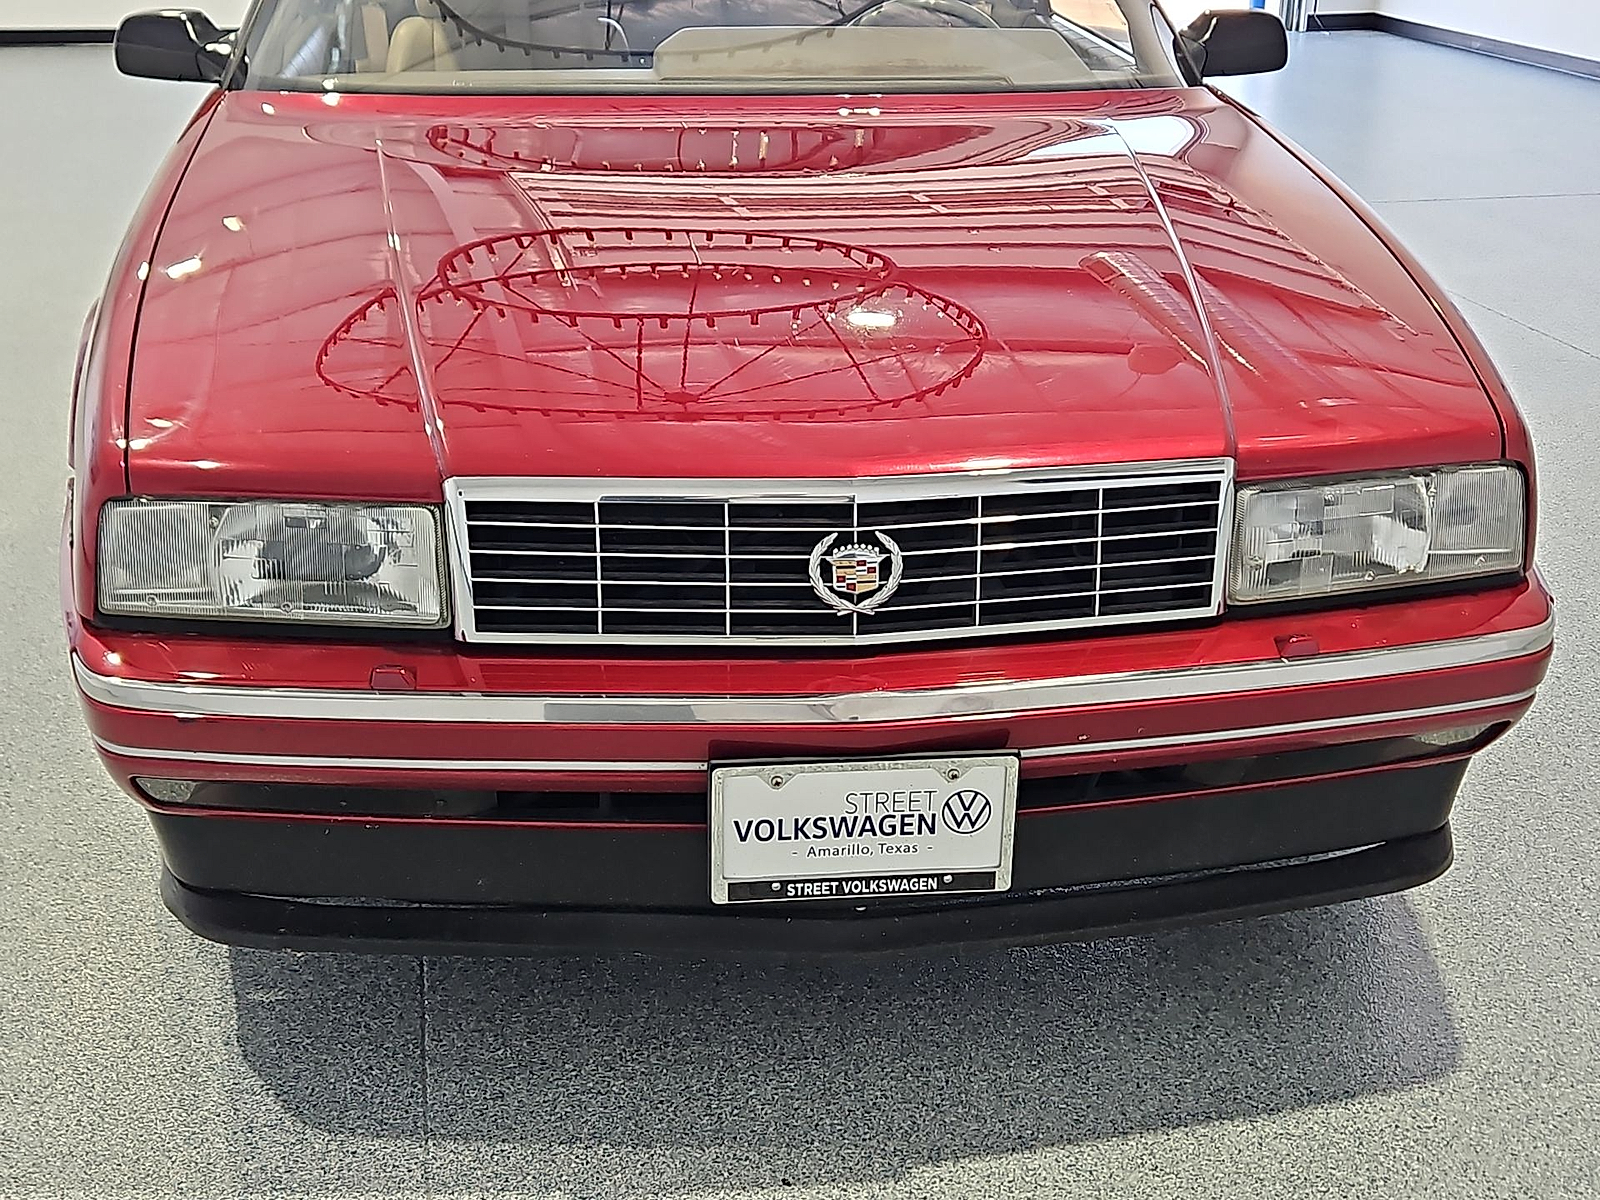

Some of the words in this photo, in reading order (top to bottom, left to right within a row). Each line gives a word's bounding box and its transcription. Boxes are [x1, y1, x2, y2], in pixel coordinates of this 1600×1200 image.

[845, 790, 938, 814] STREET
[733, 813, 937, 842] VOLKSWAGEN
[806, 843, 874, 858] Amarillo,
[877, 842, 919, 855] Texas
[786, 881, 840, 896] STREET
[842, 877, 938, 894] VOLKSWAGEN
